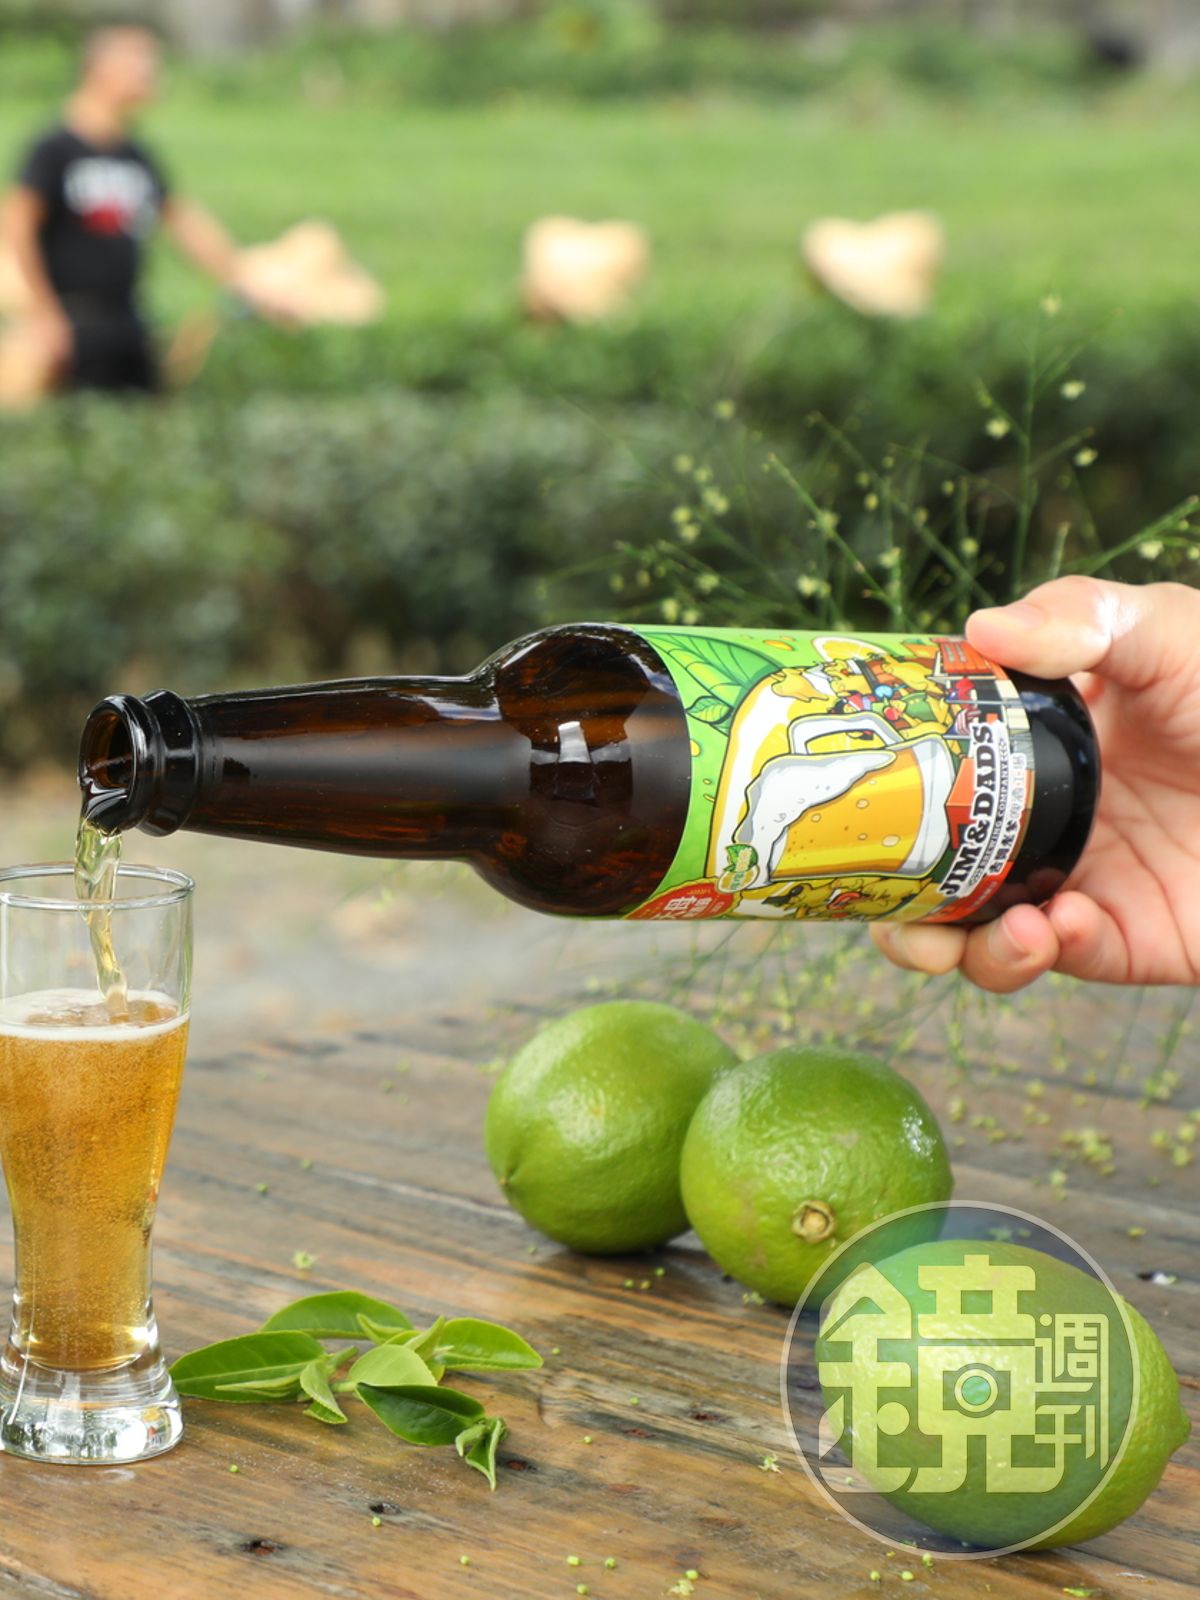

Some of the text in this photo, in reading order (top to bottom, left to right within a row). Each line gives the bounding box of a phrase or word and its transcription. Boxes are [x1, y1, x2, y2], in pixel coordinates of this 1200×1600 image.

[939, 726, 997, 895] JIM&DAD'S
[978, 818, 1002, 871] BREWING
[997, 763, 1010, 818] COMPANY
